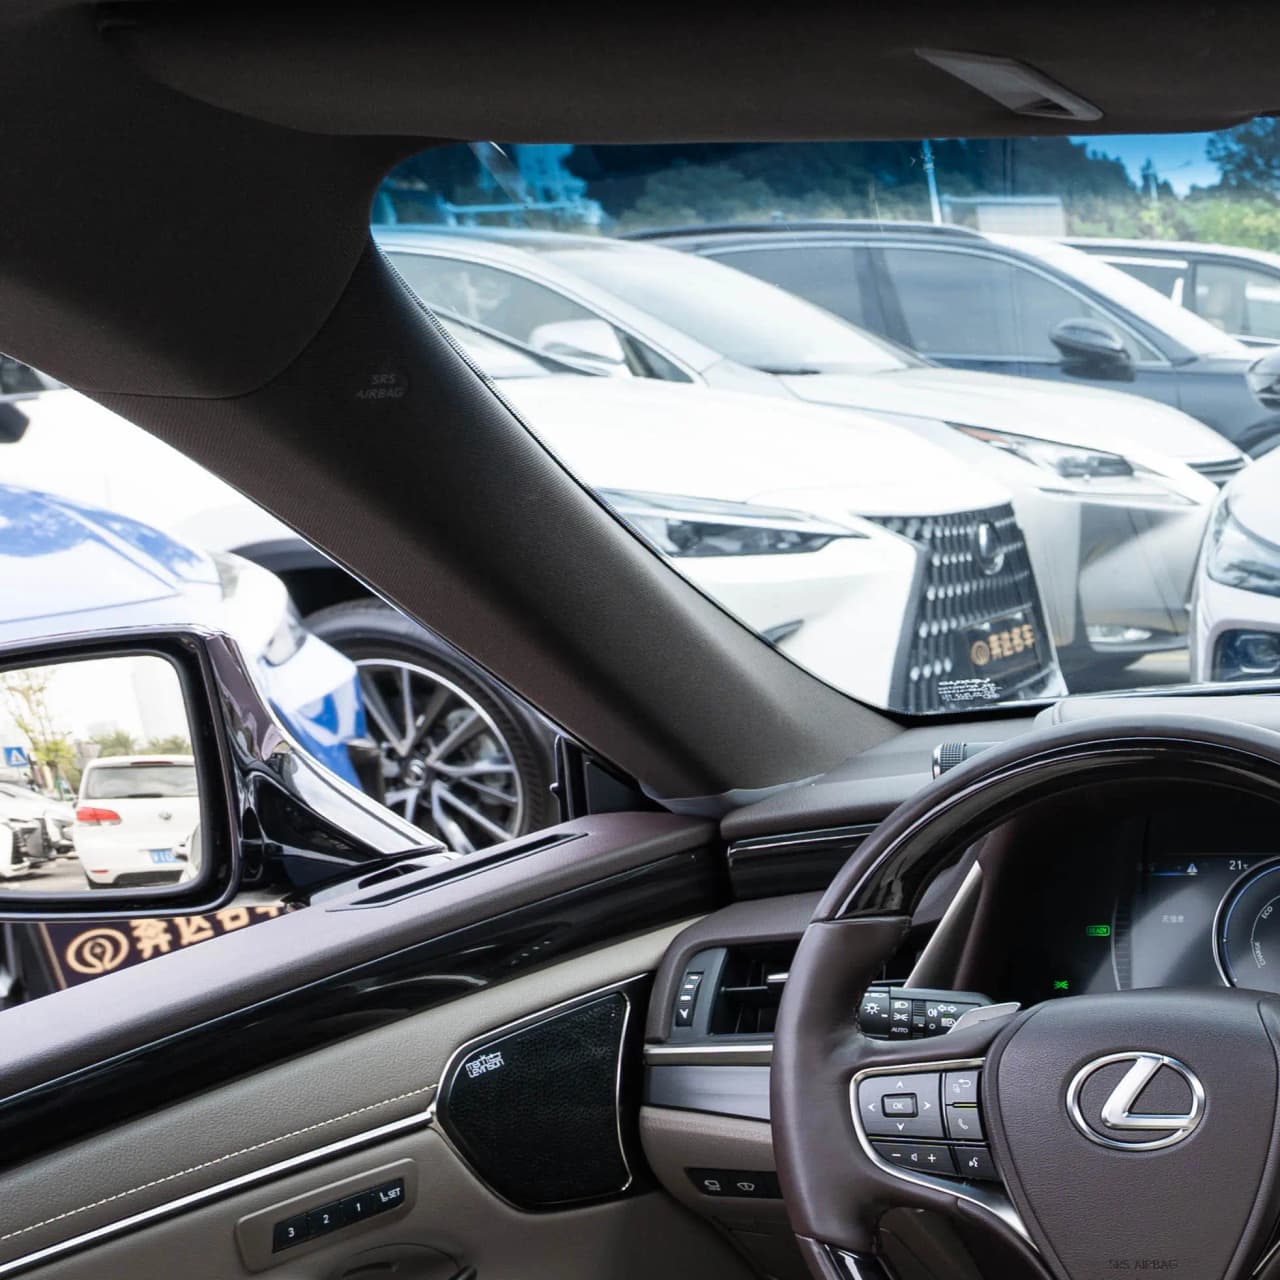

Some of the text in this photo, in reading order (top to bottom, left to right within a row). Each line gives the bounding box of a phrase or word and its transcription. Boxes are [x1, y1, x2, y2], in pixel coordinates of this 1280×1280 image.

[1261, 905, 1274, 920] ECO
[891, 1026, 909, 1034] AUTO
[892, 1102, 904, 1110] OK
[287, 1227, 295, 1238] 3
[322, 1214, 330, 1224] 2
[387, 1187, 401, 1199] SET
